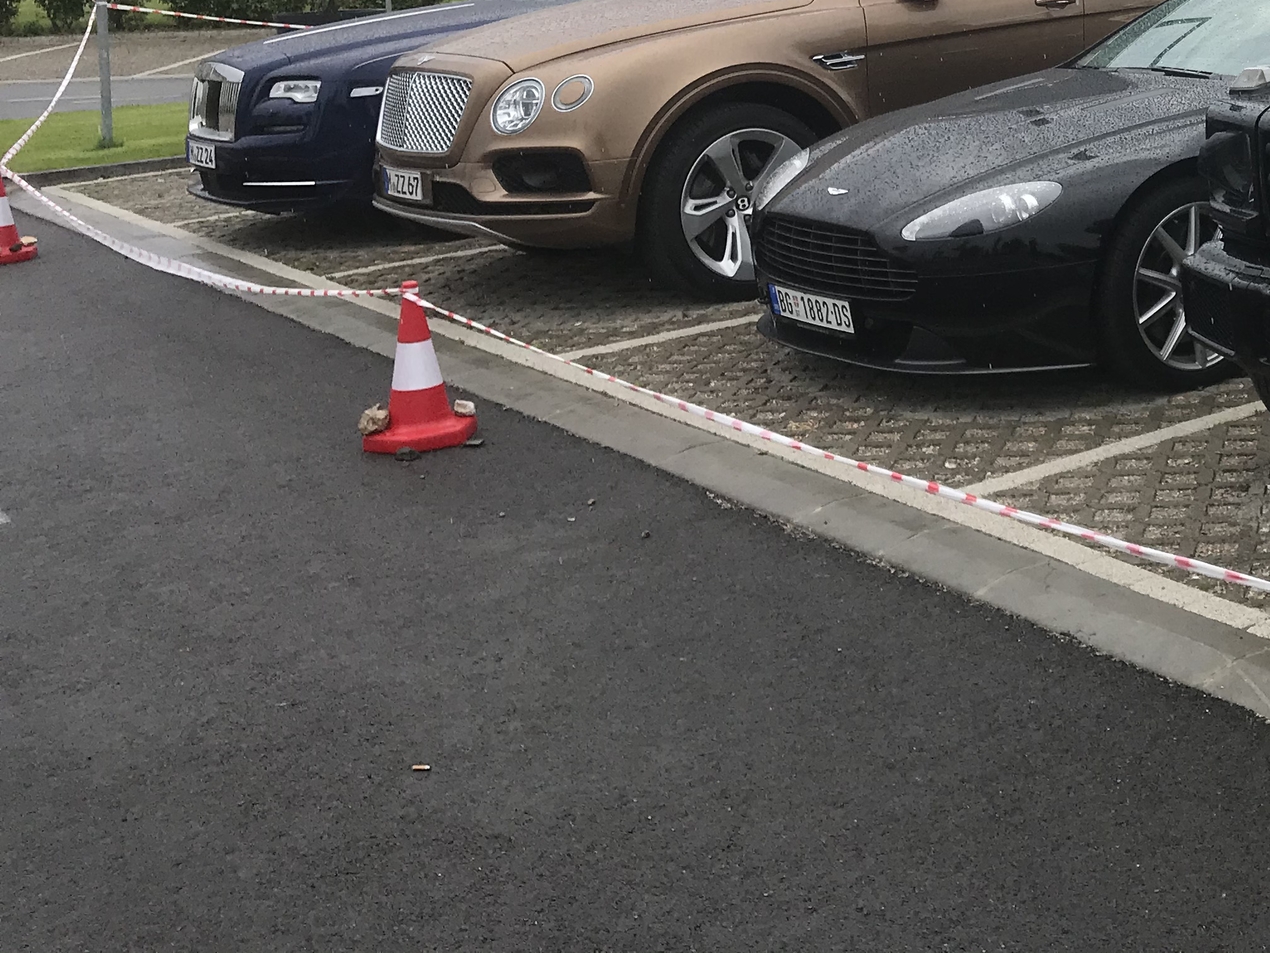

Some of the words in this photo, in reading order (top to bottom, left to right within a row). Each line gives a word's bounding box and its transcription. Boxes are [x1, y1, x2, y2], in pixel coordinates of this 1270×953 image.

[204, 147, 214, 166] 24
[408, 175, 419, 197] 67
[777, 290, 794, 315] BG
